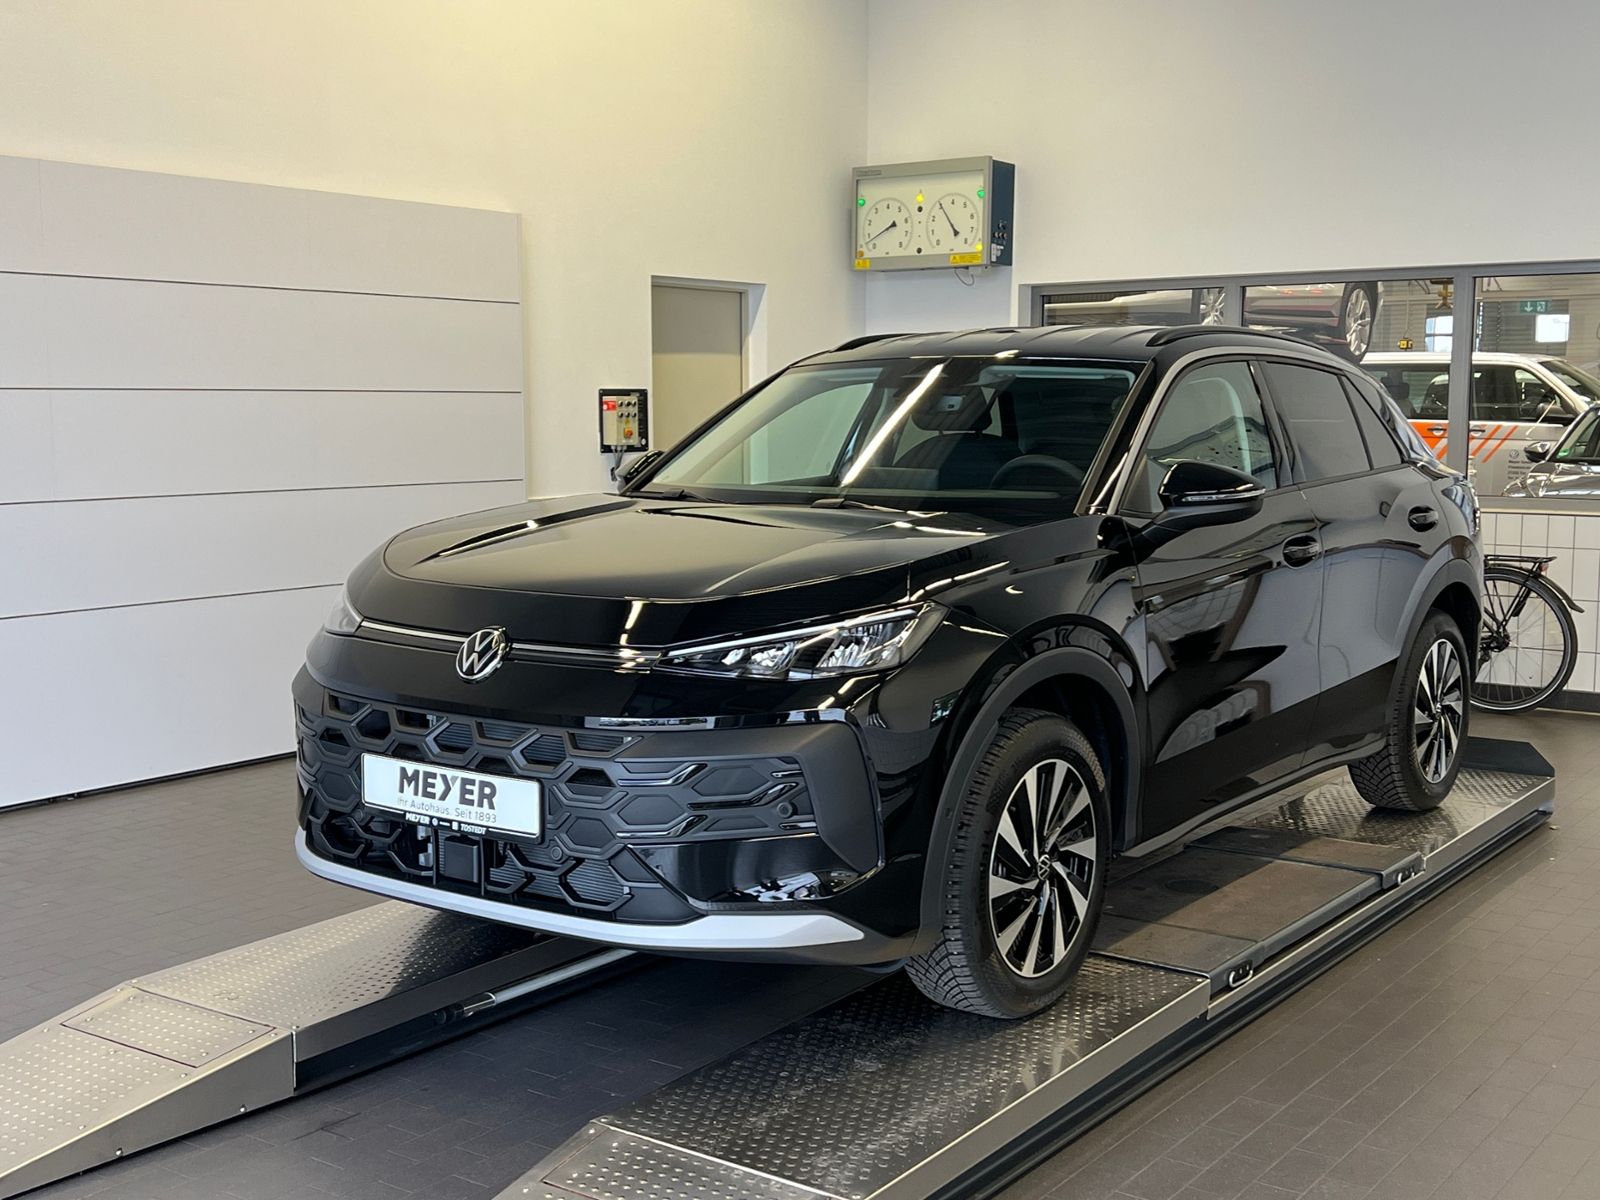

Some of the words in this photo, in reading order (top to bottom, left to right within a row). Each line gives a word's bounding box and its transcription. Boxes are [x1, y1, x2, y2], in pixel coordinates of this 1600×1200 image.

[872, 242, 877, 250] 0
[399, 766, 497, 810] MEYER
[397, 798, 407, 807] Ihr
[455, 808, 472, 820] Seit
[475, 811, 497, 824] 1893
[406, 812, 430, 825] MEYER
[460, 823, 487, 835] TOSTEDT
